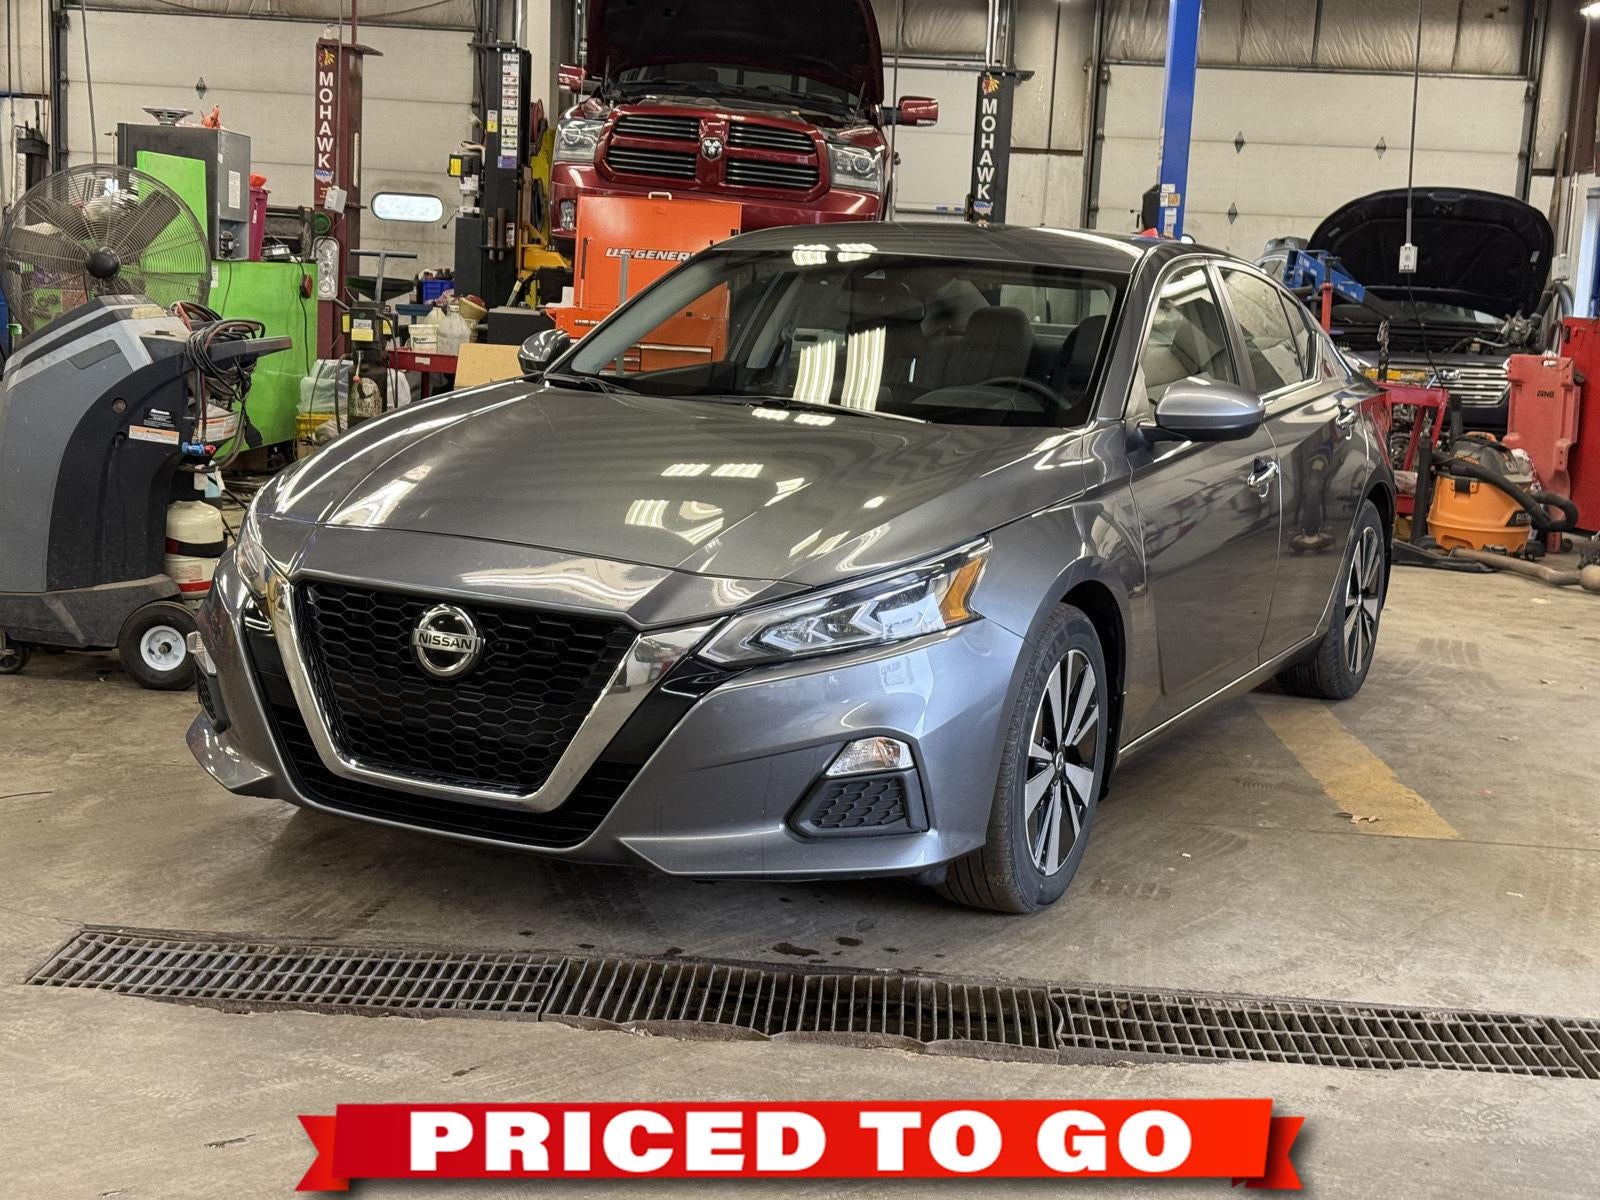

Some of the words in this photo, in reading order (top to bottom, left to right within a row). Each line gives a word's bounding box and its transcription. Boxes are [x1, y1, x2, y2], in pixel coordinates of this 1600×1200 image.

[316, 71, 334, 169] MOHAWK
[976, 98, 998, 200] MOHAWK
[633, 249, 696, 261] GENER
[418, 632, 472, 650] NISSAN
